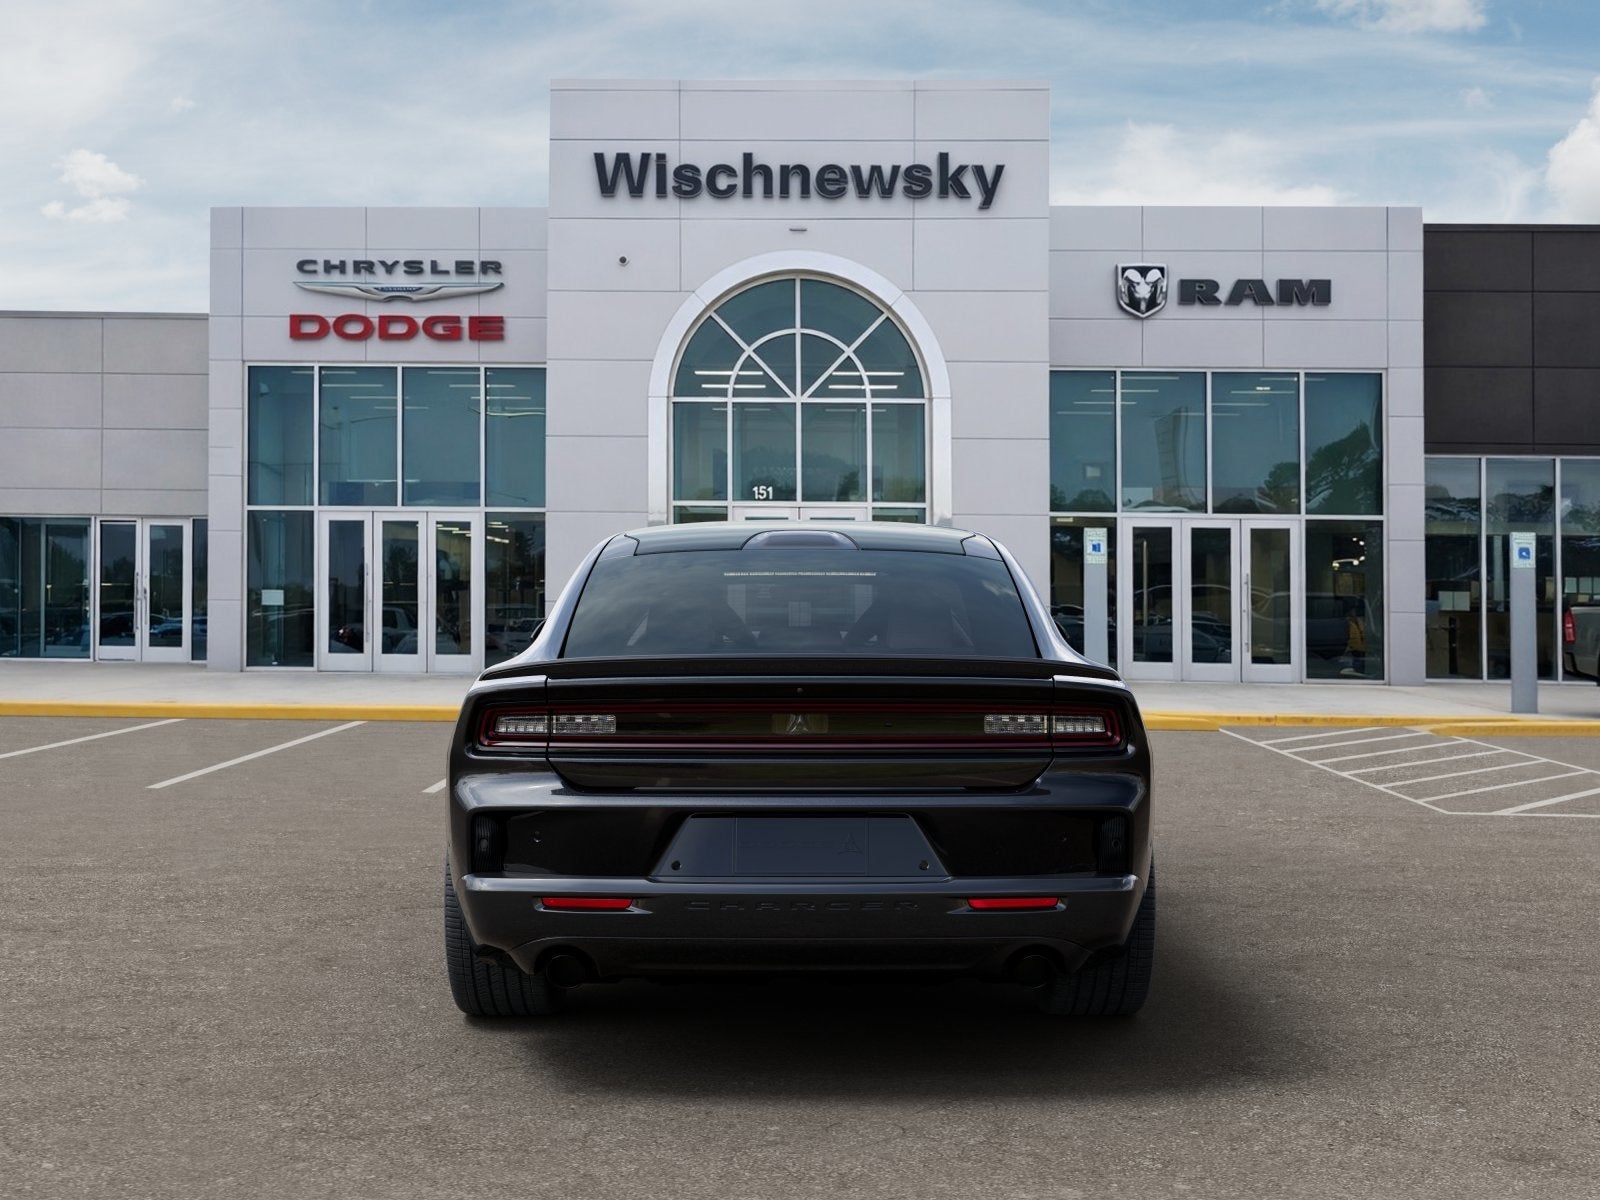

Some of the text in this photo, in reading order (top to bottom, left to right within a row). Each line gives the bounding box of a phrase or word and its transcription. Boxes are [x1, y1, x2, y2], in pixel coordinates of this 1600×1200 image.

[594, 152, 1005, 210] Wischnewsky
[296, 259, 503, 275] CHRYSLER
[1178, 278, 1331, 306] RAM
[289, 314, 505, 341] DODGE
[752, 485, 773, 500] 151
